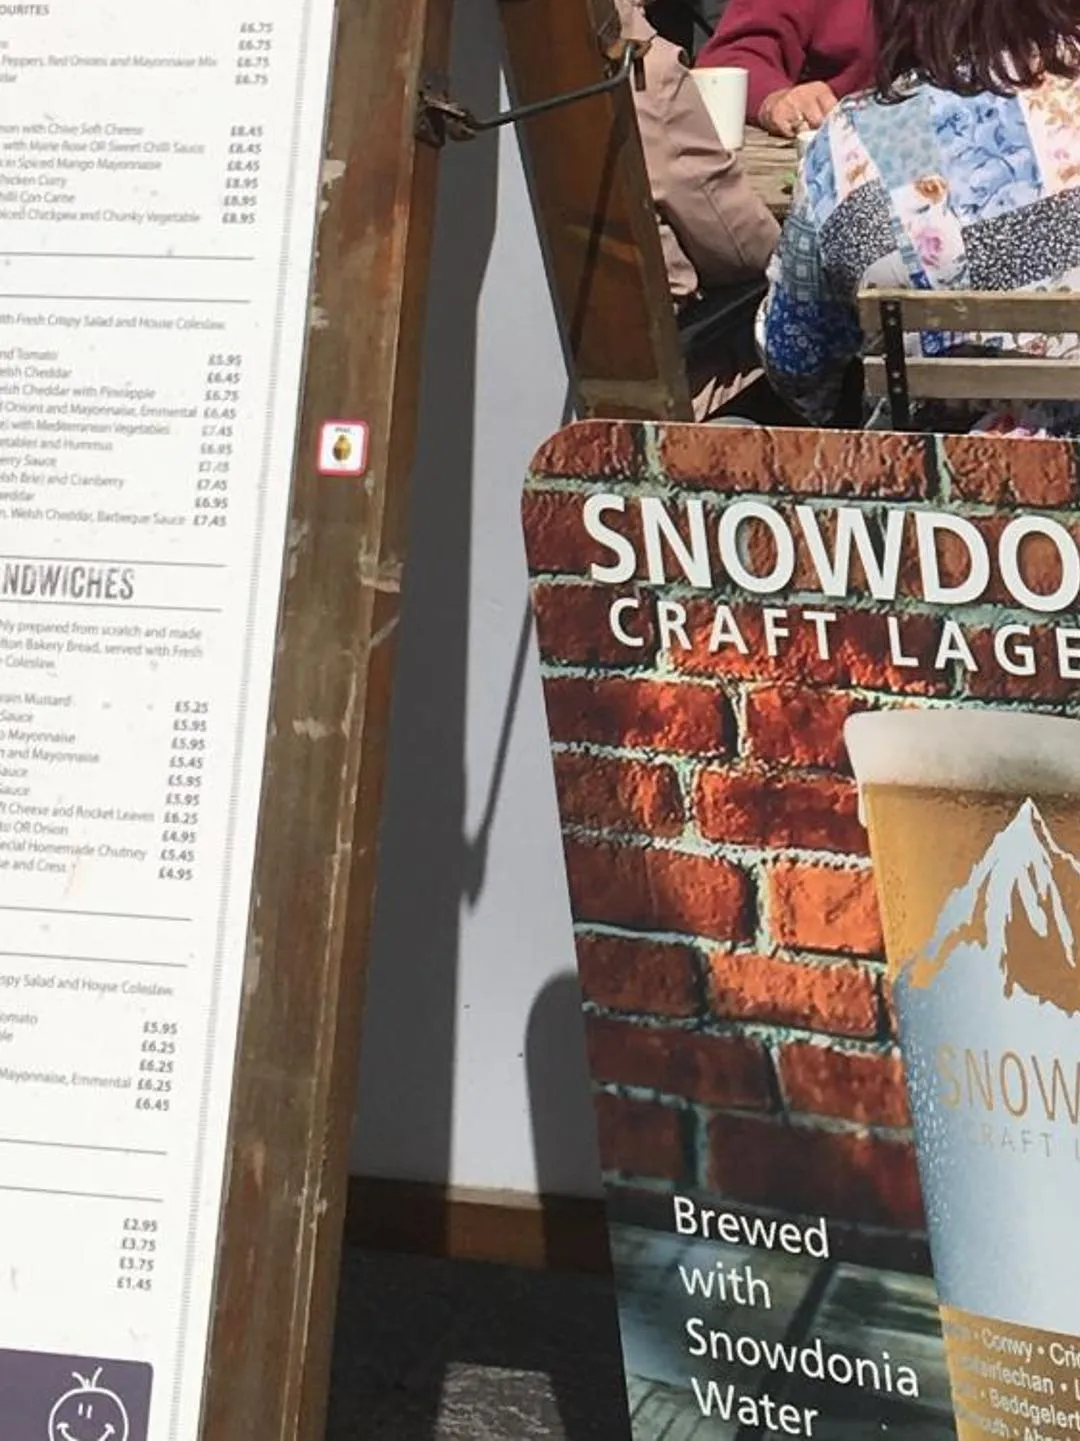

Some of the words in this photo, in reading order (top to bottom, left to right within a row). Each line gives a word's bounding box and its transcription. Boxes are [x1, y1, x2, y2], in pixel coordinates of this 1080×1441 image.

[3, 563, 135, 600] NDWICHES
[608, 597, 839, 661] CRAFT
[174, 701, 208, 714] £5.25
[173, 718, 207, 732] £5.95
[171, 737, 205, 750] £5.95
[169, 756, 204, 769] £5.45
[168, 774, 201, 788] £5.95
[166, 793, 200, 806] £5.95
[163, 812, 198, 825] £6.25
[162, 830, 196, 843] £4.95
[161, 849, 195, 862] £5.45
[158, 866, 193, 880] £4.95
[143, 1020, 178, 1035] £5.95
[141, 1039, 176, 1054] £6.25
[139, 1059, 174, 1073] £6.25
[137, 1078, 172, 1092] £6.25
[135, 1097, 170, 1111] £6.45
[122, 1218, 158, 1232] £2.95
[673, 1195, 830, 1258] Brewed
[121, 1237, 156, 1252] £3.75
[119, 1256, 154, 1272] £3.75
[117, 1276, 152, 1291] £1.45
[679, 1263, 772, 1310] with
[981, 1327, 1033, 1363] Conwy
[686, 1317, 920, 1399] Snowdonia
[691, 1377, 819, 1437] Water
